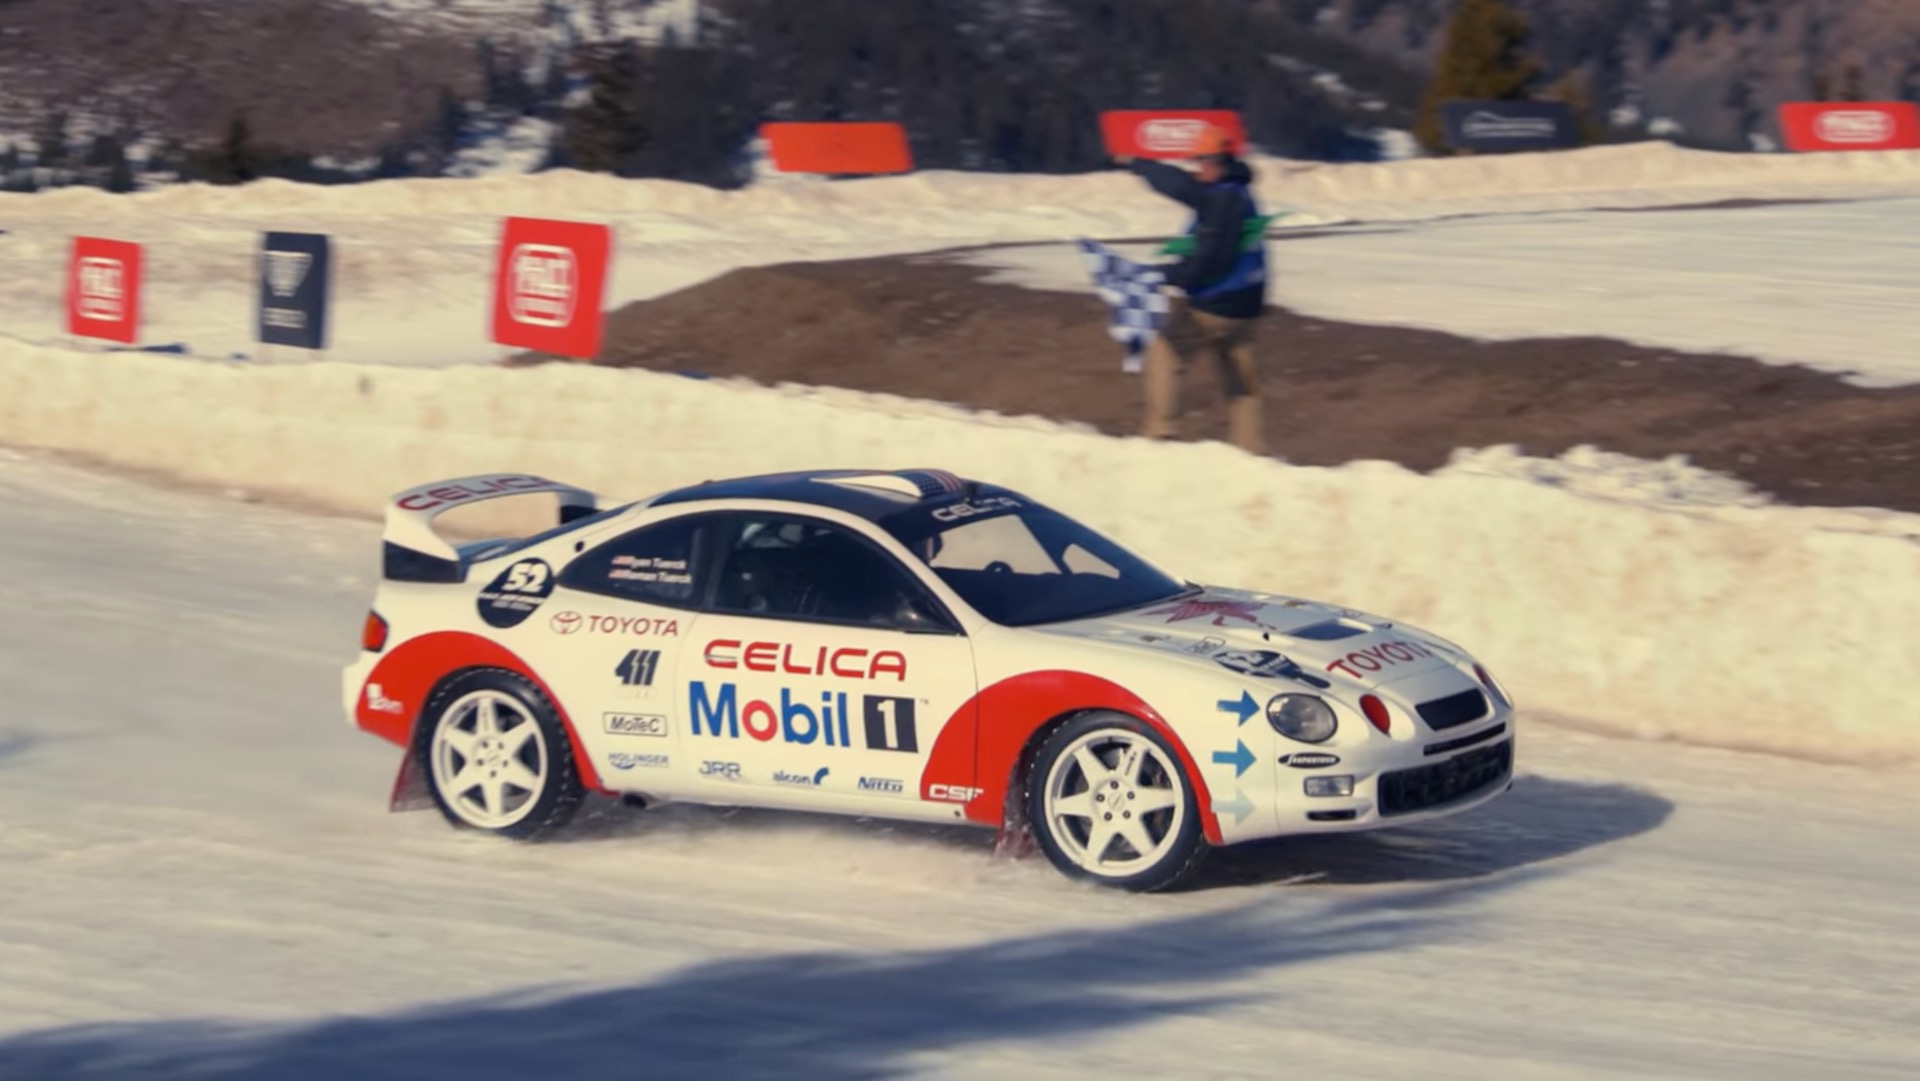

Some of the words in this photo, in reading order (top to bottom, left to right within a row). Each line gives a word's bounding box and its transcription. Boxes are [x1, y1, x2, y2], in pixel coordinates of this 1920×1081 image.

[501, 562, 548, 593] 52
[588, 615, 678, 636] TOYOTA
[704, 639, 907, 682] CELICA
[609, 715, 661, 733] MoTeC
[689, 680, 851, 748] Mobil
[857, 776, 904, 793] Nitto
[928, 783, 985, 802] CSF
